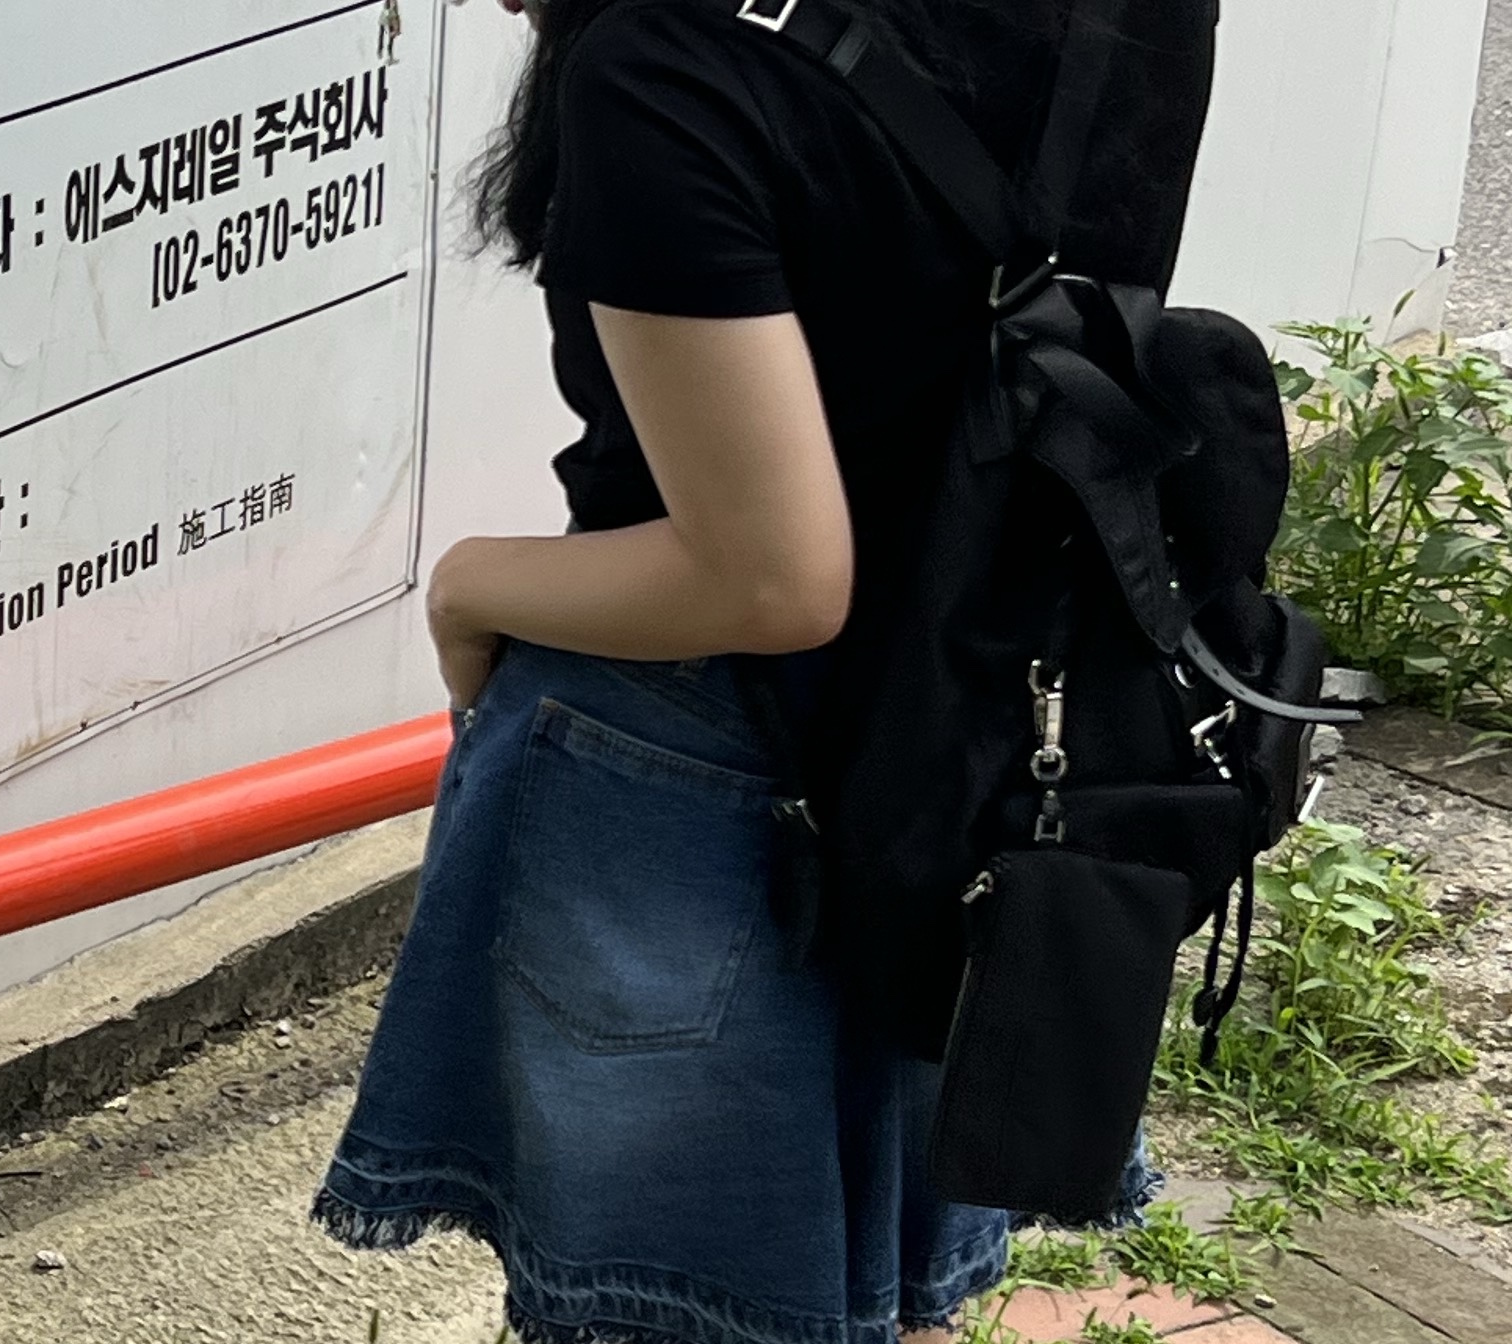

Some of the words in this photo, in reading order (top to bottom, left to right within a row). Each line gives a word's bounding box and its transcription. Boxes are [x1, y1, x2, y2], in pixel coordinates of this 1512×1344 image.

[64, 113, 243, 245] 에스지레일
[253, 65, 388, 179] 주식회사
[151, 162, 385, 309] [02-6370-5921]
[57, 522, 159, 610] Period
[177, 472, 296, 556] 施工指南
